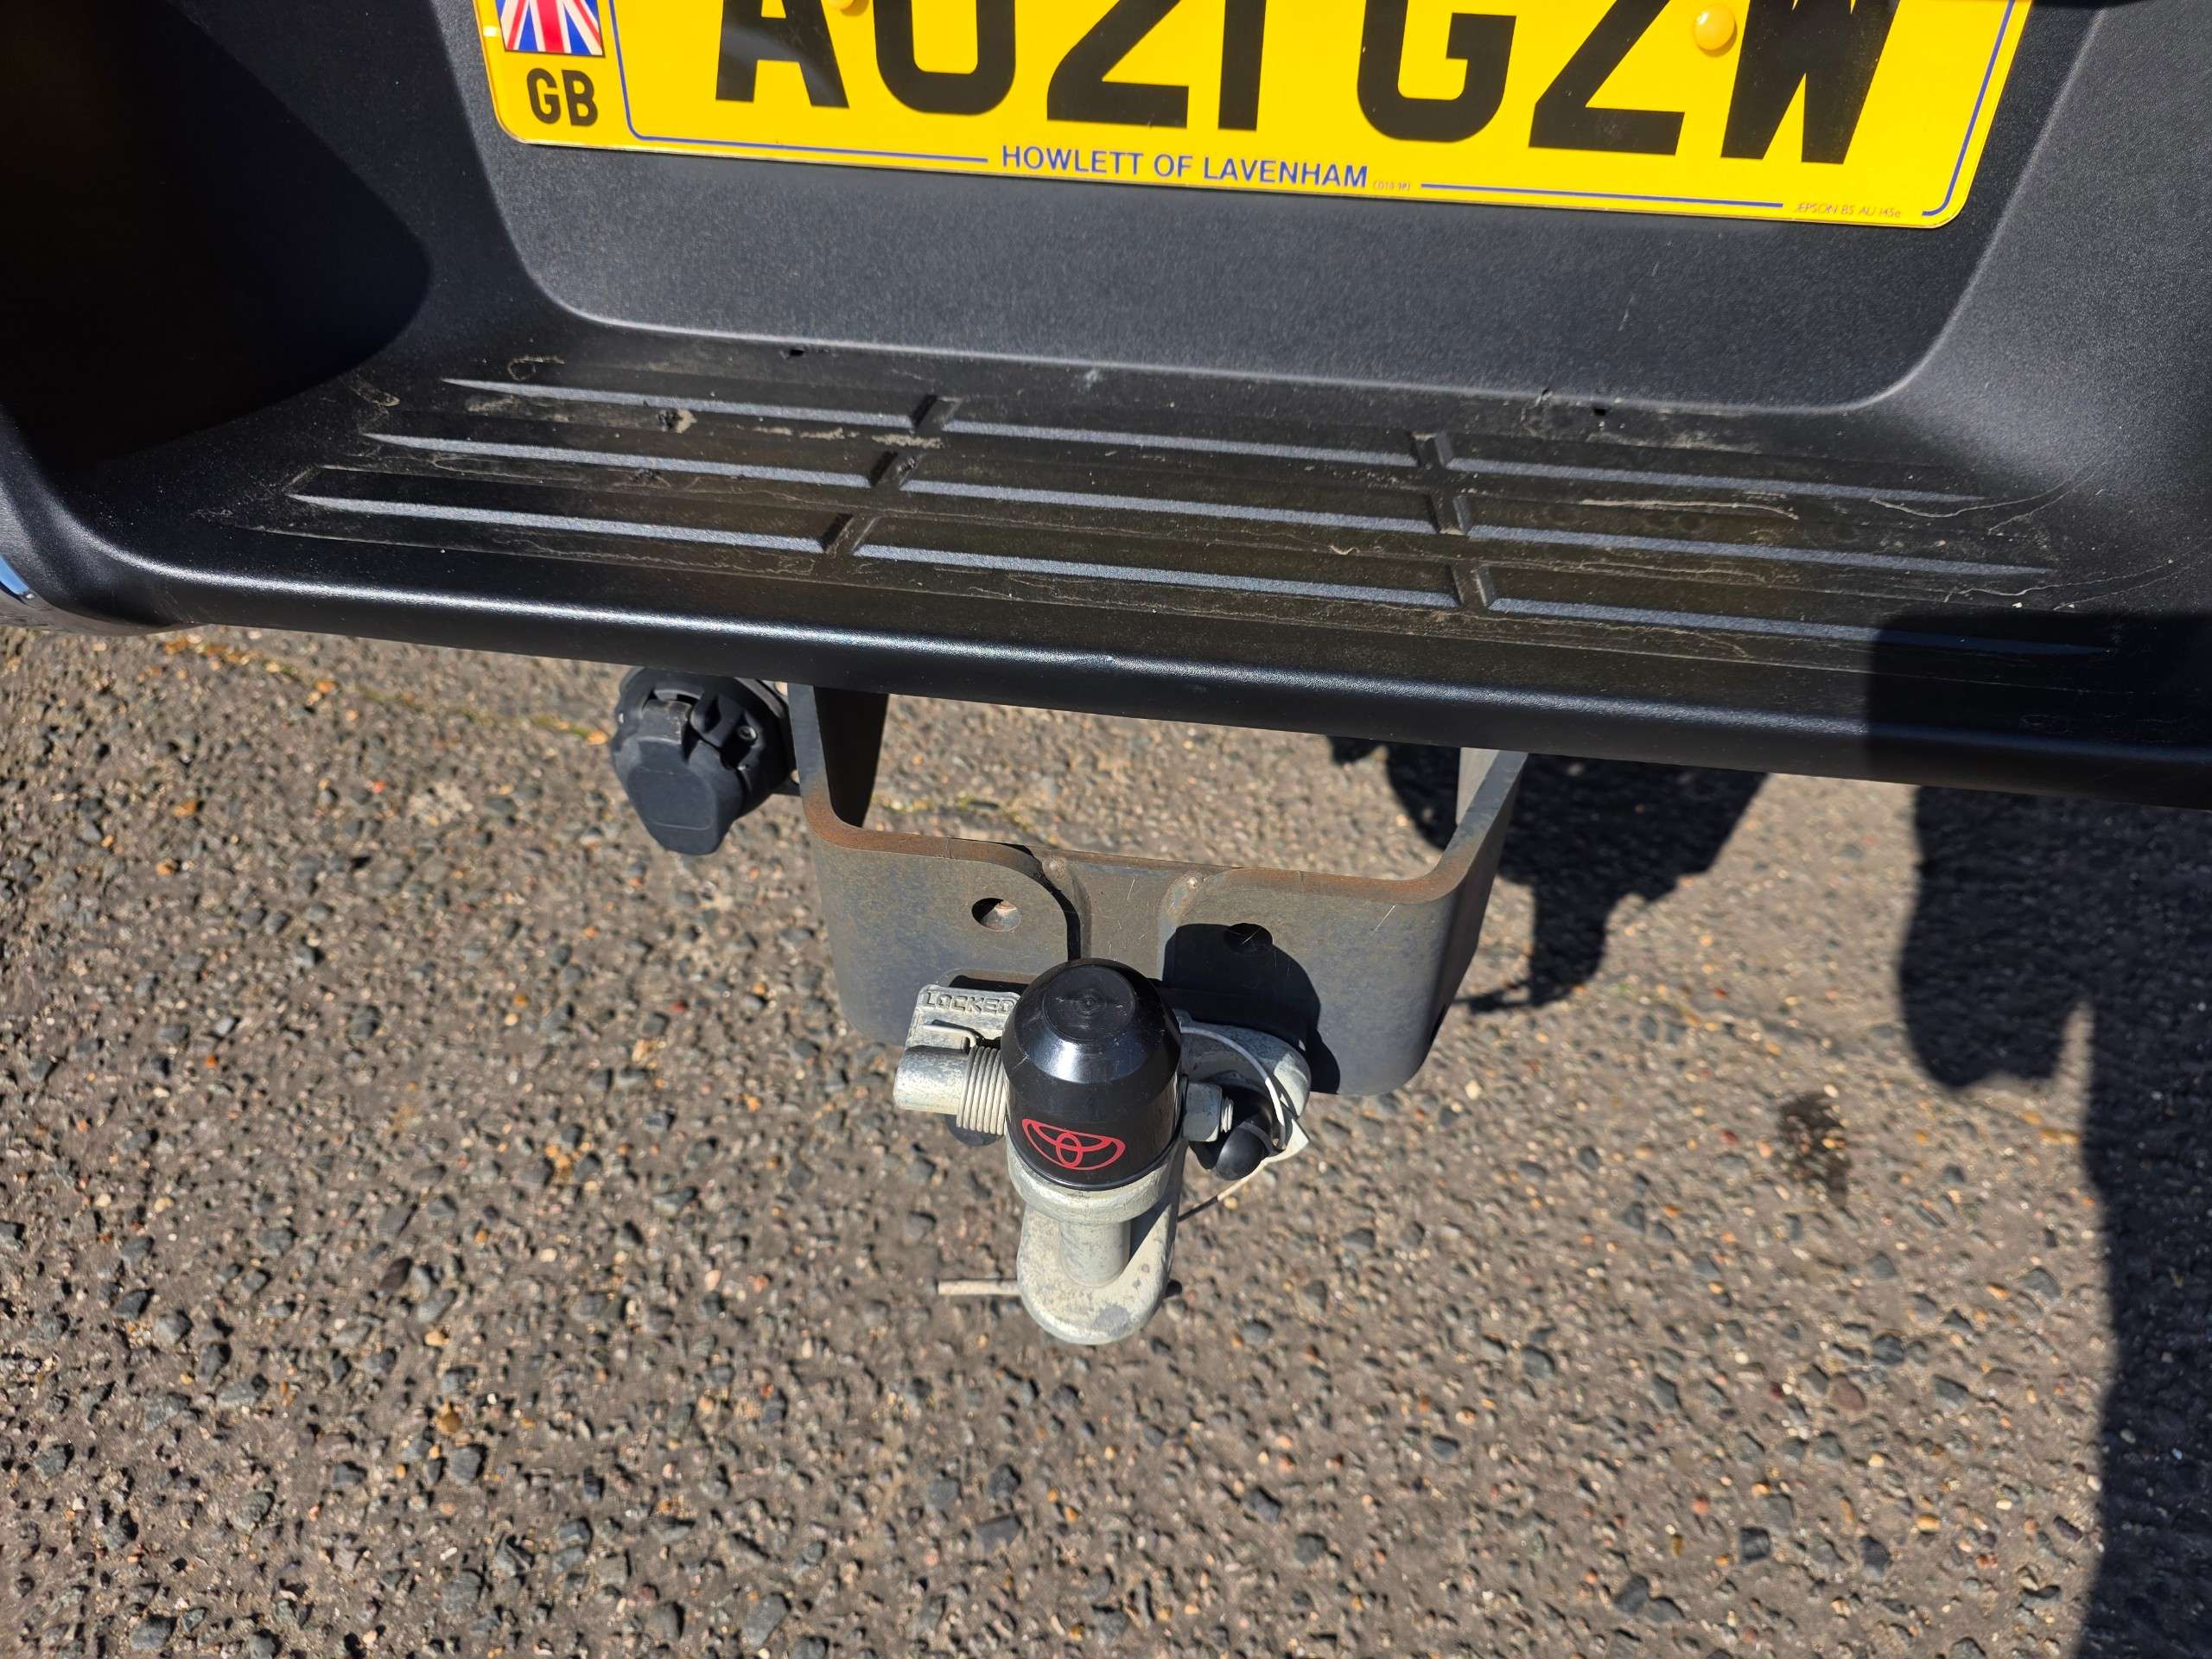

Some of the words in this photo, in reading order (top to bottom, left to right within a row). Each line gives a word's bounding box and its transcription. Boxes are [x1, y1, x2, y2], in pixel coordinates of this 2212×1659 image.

[526, 67, 598, 127] GB
[1357, 0, 1901, 164] GZW
[1002, 144, 1144, 175] HOWLETT
[1154, 153, 1193, 178] OF
[1204, 156, 1368, 188] LAVENHAM
[925, 989, 1016, 1015] LOCKED
